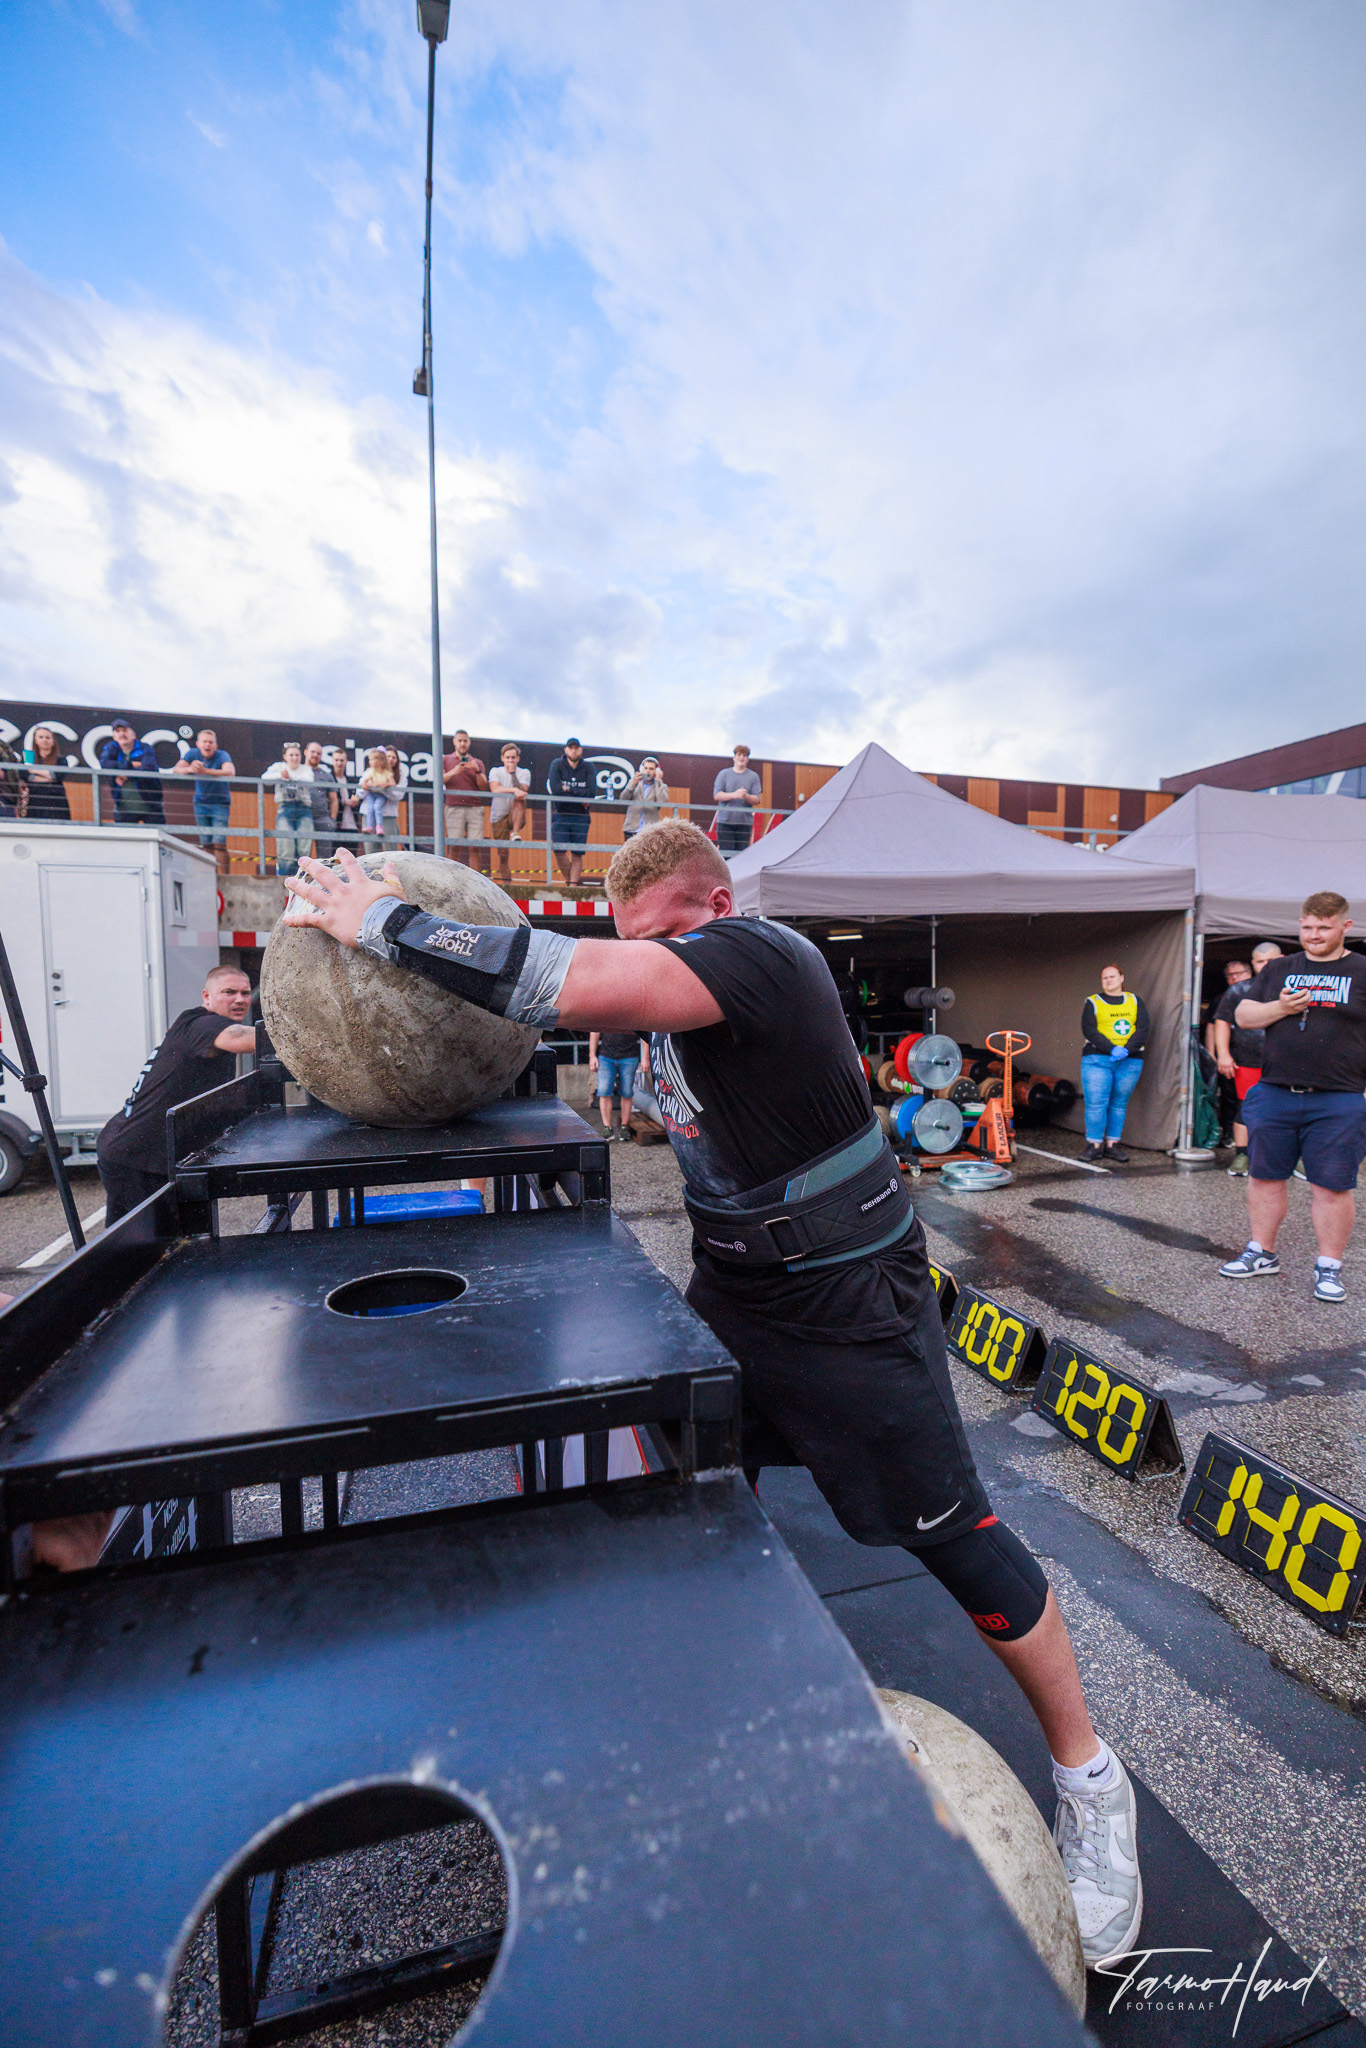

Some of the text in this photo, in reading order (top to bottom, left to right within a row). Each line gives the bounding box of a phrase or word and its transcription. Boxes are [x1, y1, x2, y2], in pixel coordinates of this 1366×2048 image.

[321, 739, 434, 782] sinsa
[958, 1301, 1025, 1382] 100
[1054, 1358, 1146, 1465] 120
[1217, 1464, 1362, 1612] 140
